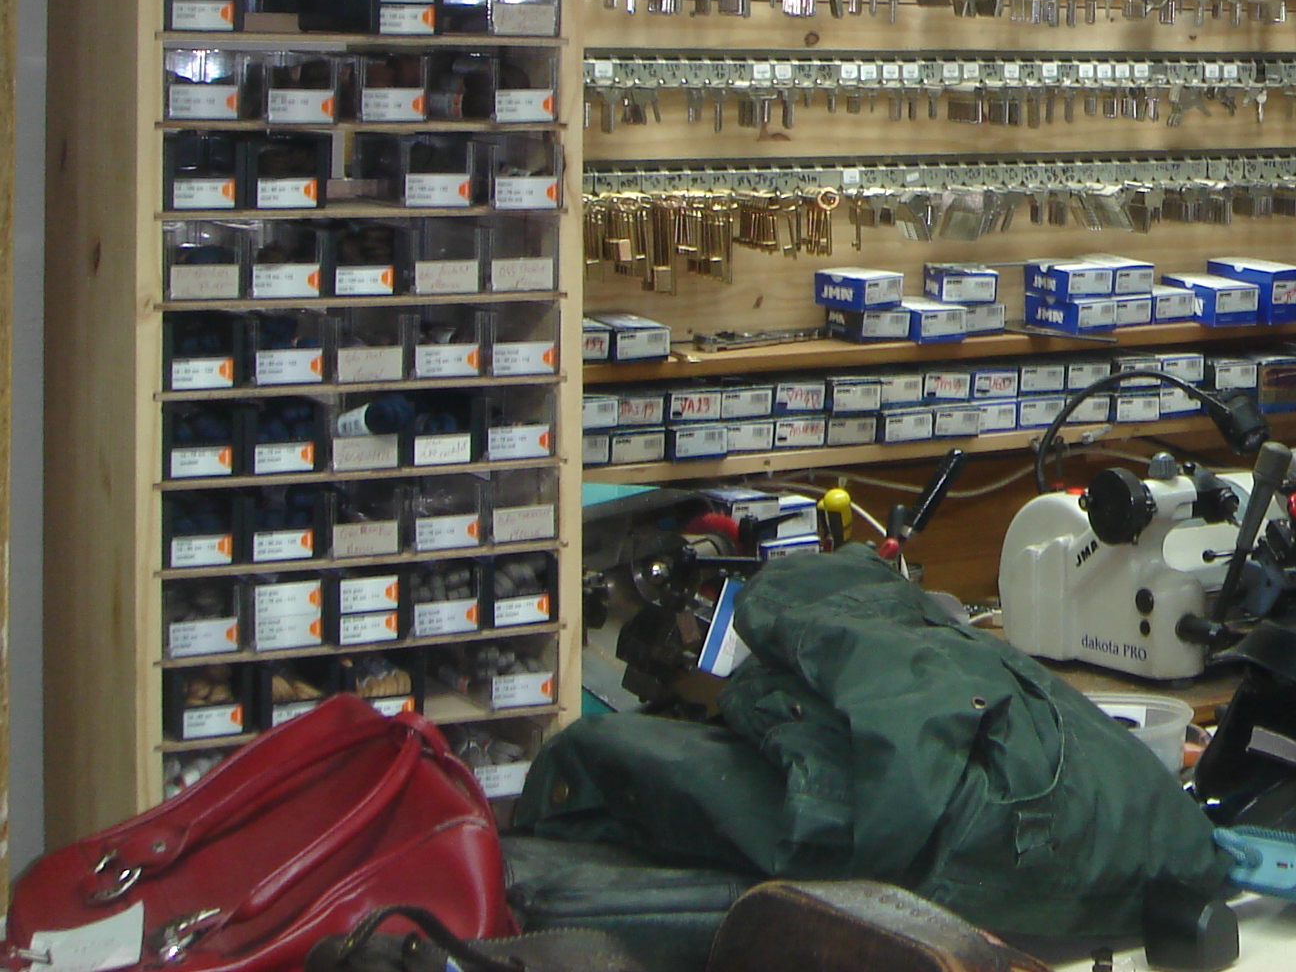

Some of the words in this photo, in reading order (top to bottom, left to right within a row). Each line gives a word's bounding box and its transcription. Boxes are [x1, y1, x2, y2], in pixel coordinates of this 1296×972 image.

[1076, 540, 1098, 567] JMA
[1081, 634, 1119, 655] dakota
[1123, 644, 1147, 661] PRO
